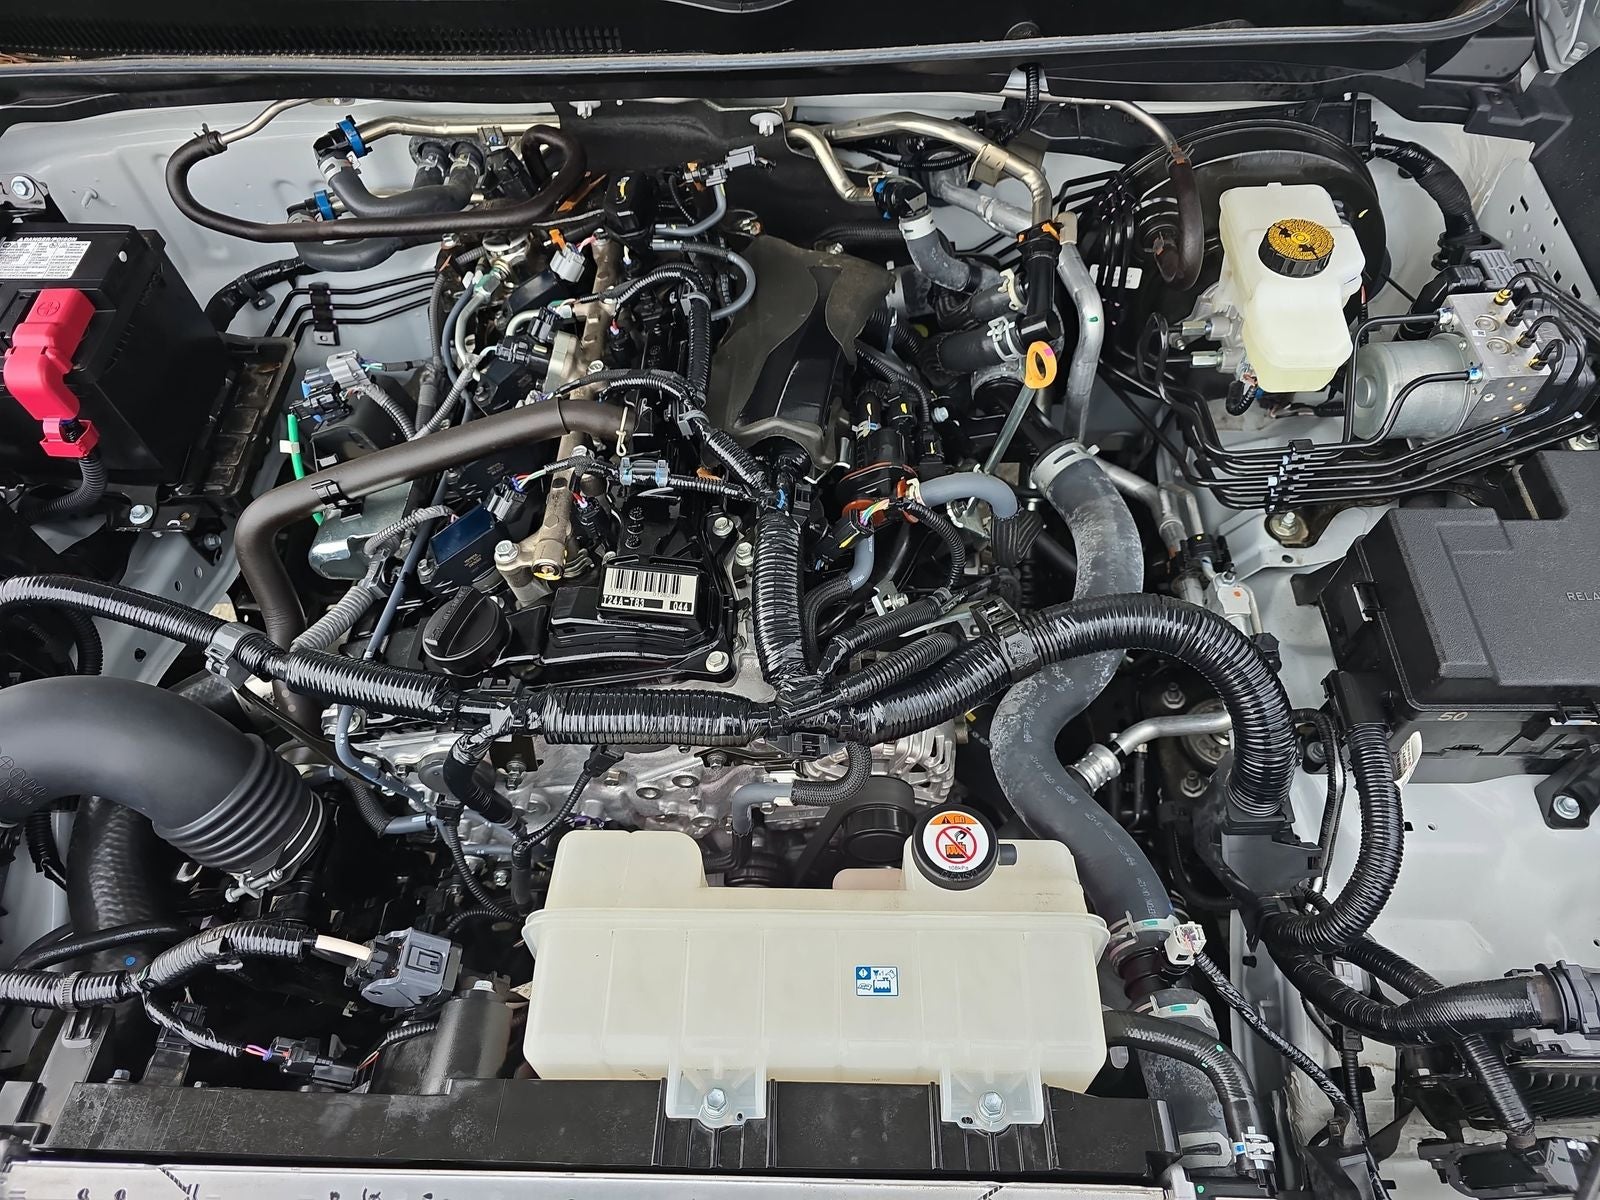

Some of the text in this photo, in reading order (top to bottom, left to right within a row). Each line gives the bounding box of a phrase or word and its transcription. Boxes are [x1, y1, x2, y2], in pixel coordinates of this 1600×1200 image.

[603, 595, 645, 608] T24A-T83
[673, 600, 689, 611] 044
[1437, 711, 1469, 721] 50
